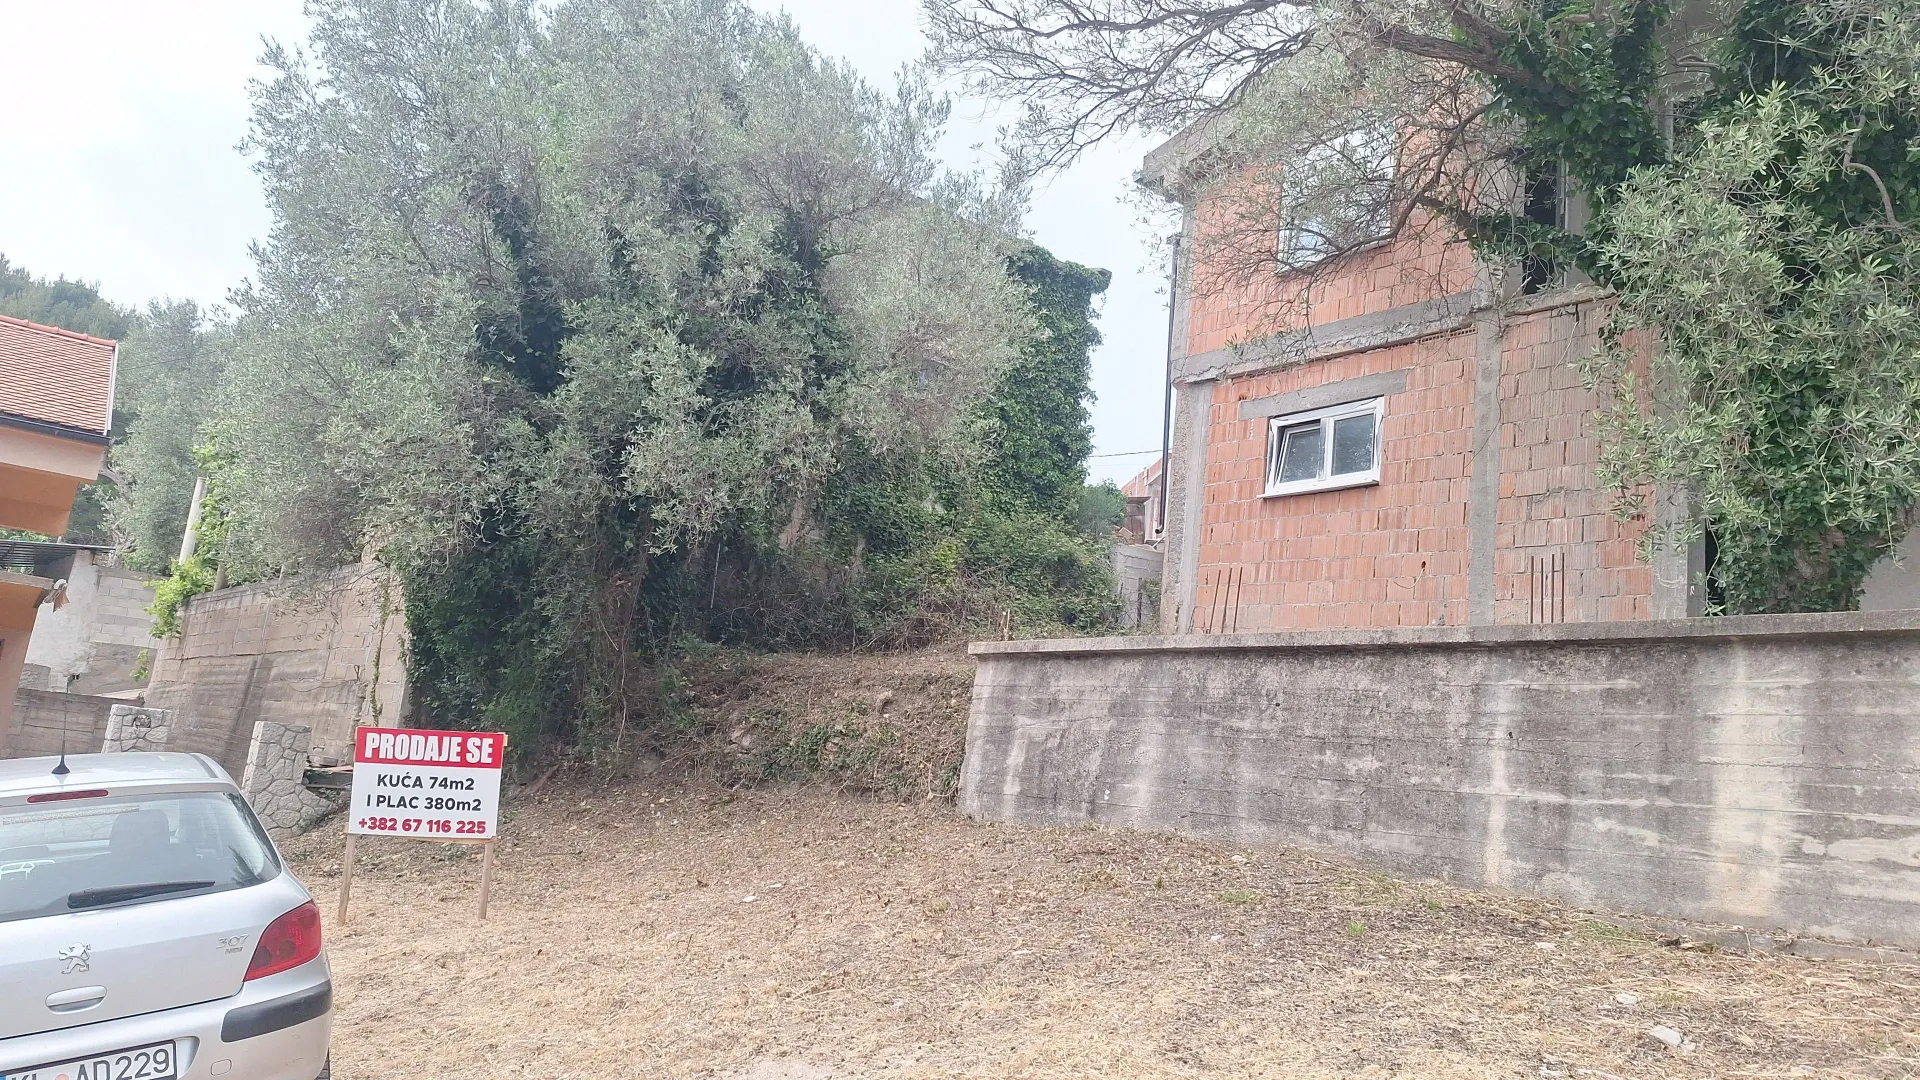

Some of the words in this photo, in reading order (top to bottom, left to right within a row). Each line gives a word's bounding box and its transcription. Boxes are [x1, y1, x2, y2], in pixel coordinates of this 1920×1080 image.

[364, 732, 462, 763] PRODAJE
[465, 737, 494, 764] SE
[377, 772, 424, 789] KUĆA
[429, 776, 475, 791] 74m2
[366, 794, 371, 807] I
[376, 795, 420, 809] PLAC
[424, 797, 482, 811] 380m2
[358, 817, 398, 831] +382
[401, 818, 423, 832] 67
[426, 819, 451, 833] 116
[455, 821, 486, 834] 225
[214, 932, 250, 949] 307
